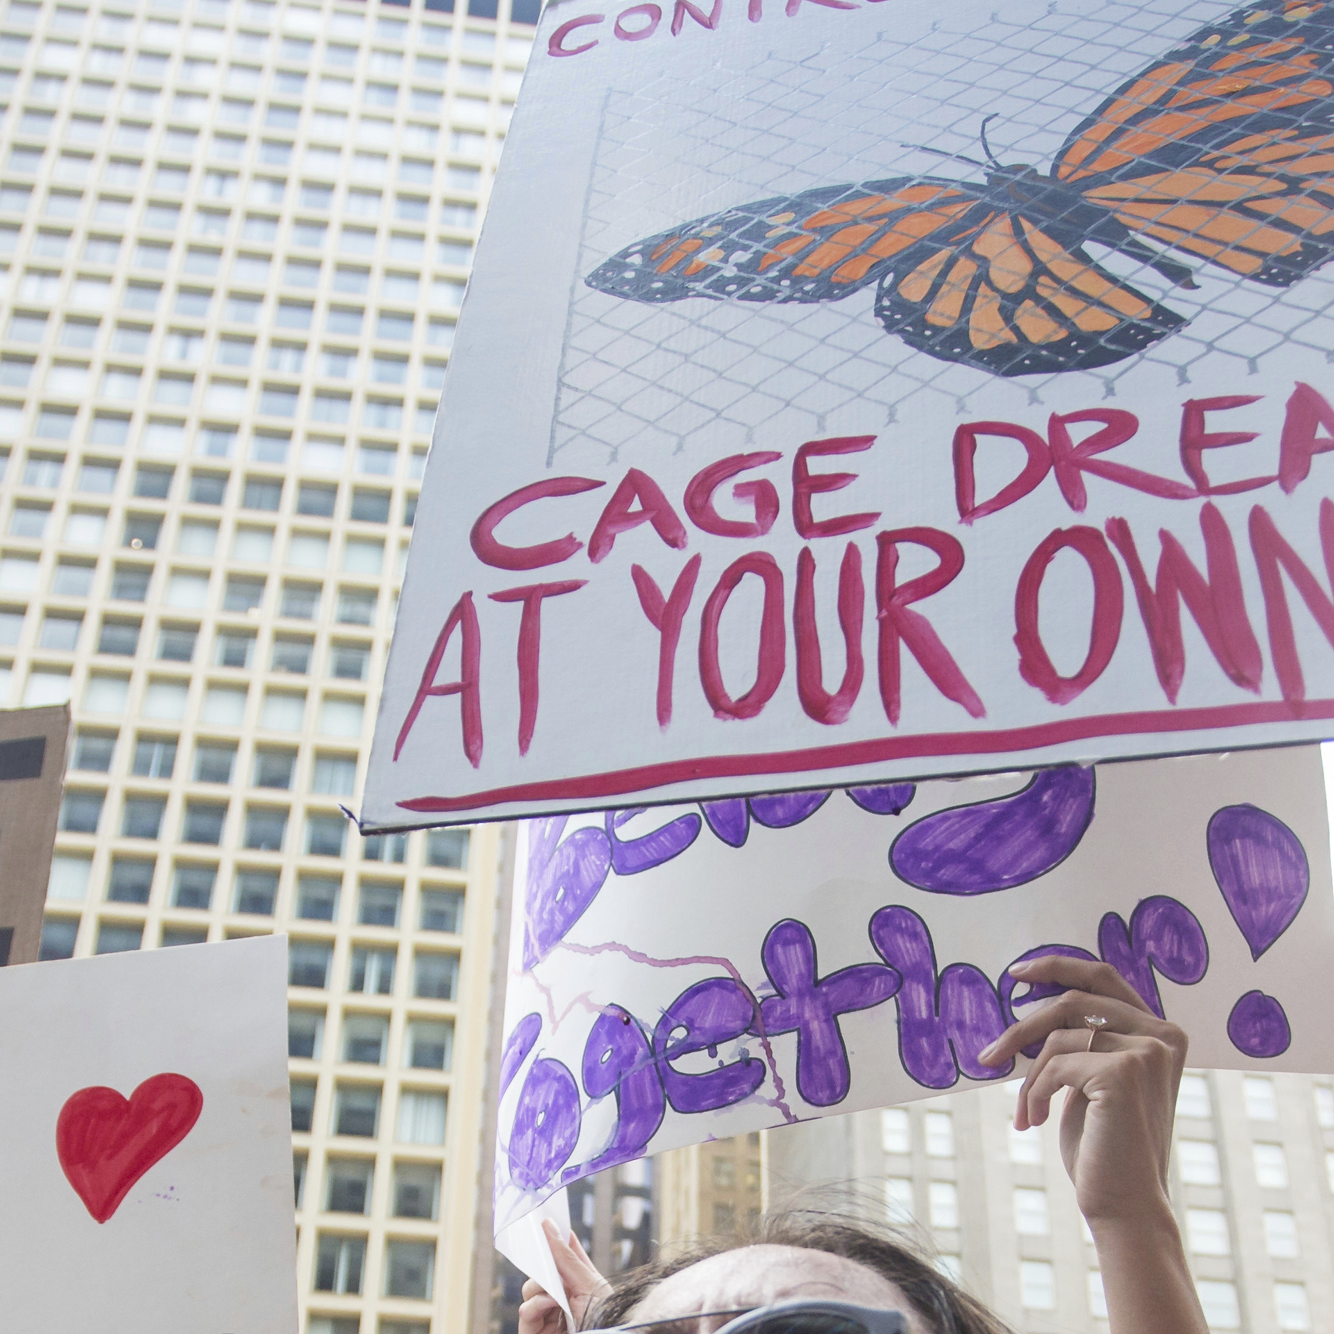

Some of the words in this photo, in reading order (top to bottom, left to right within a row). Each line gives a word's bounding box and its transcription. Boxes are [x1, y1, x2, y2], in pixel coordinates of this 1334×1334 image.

[470, 435, 882, 571] CAGE
[393, 578, 587, 768] AT
[631, 526, 983, 727] YOUR
